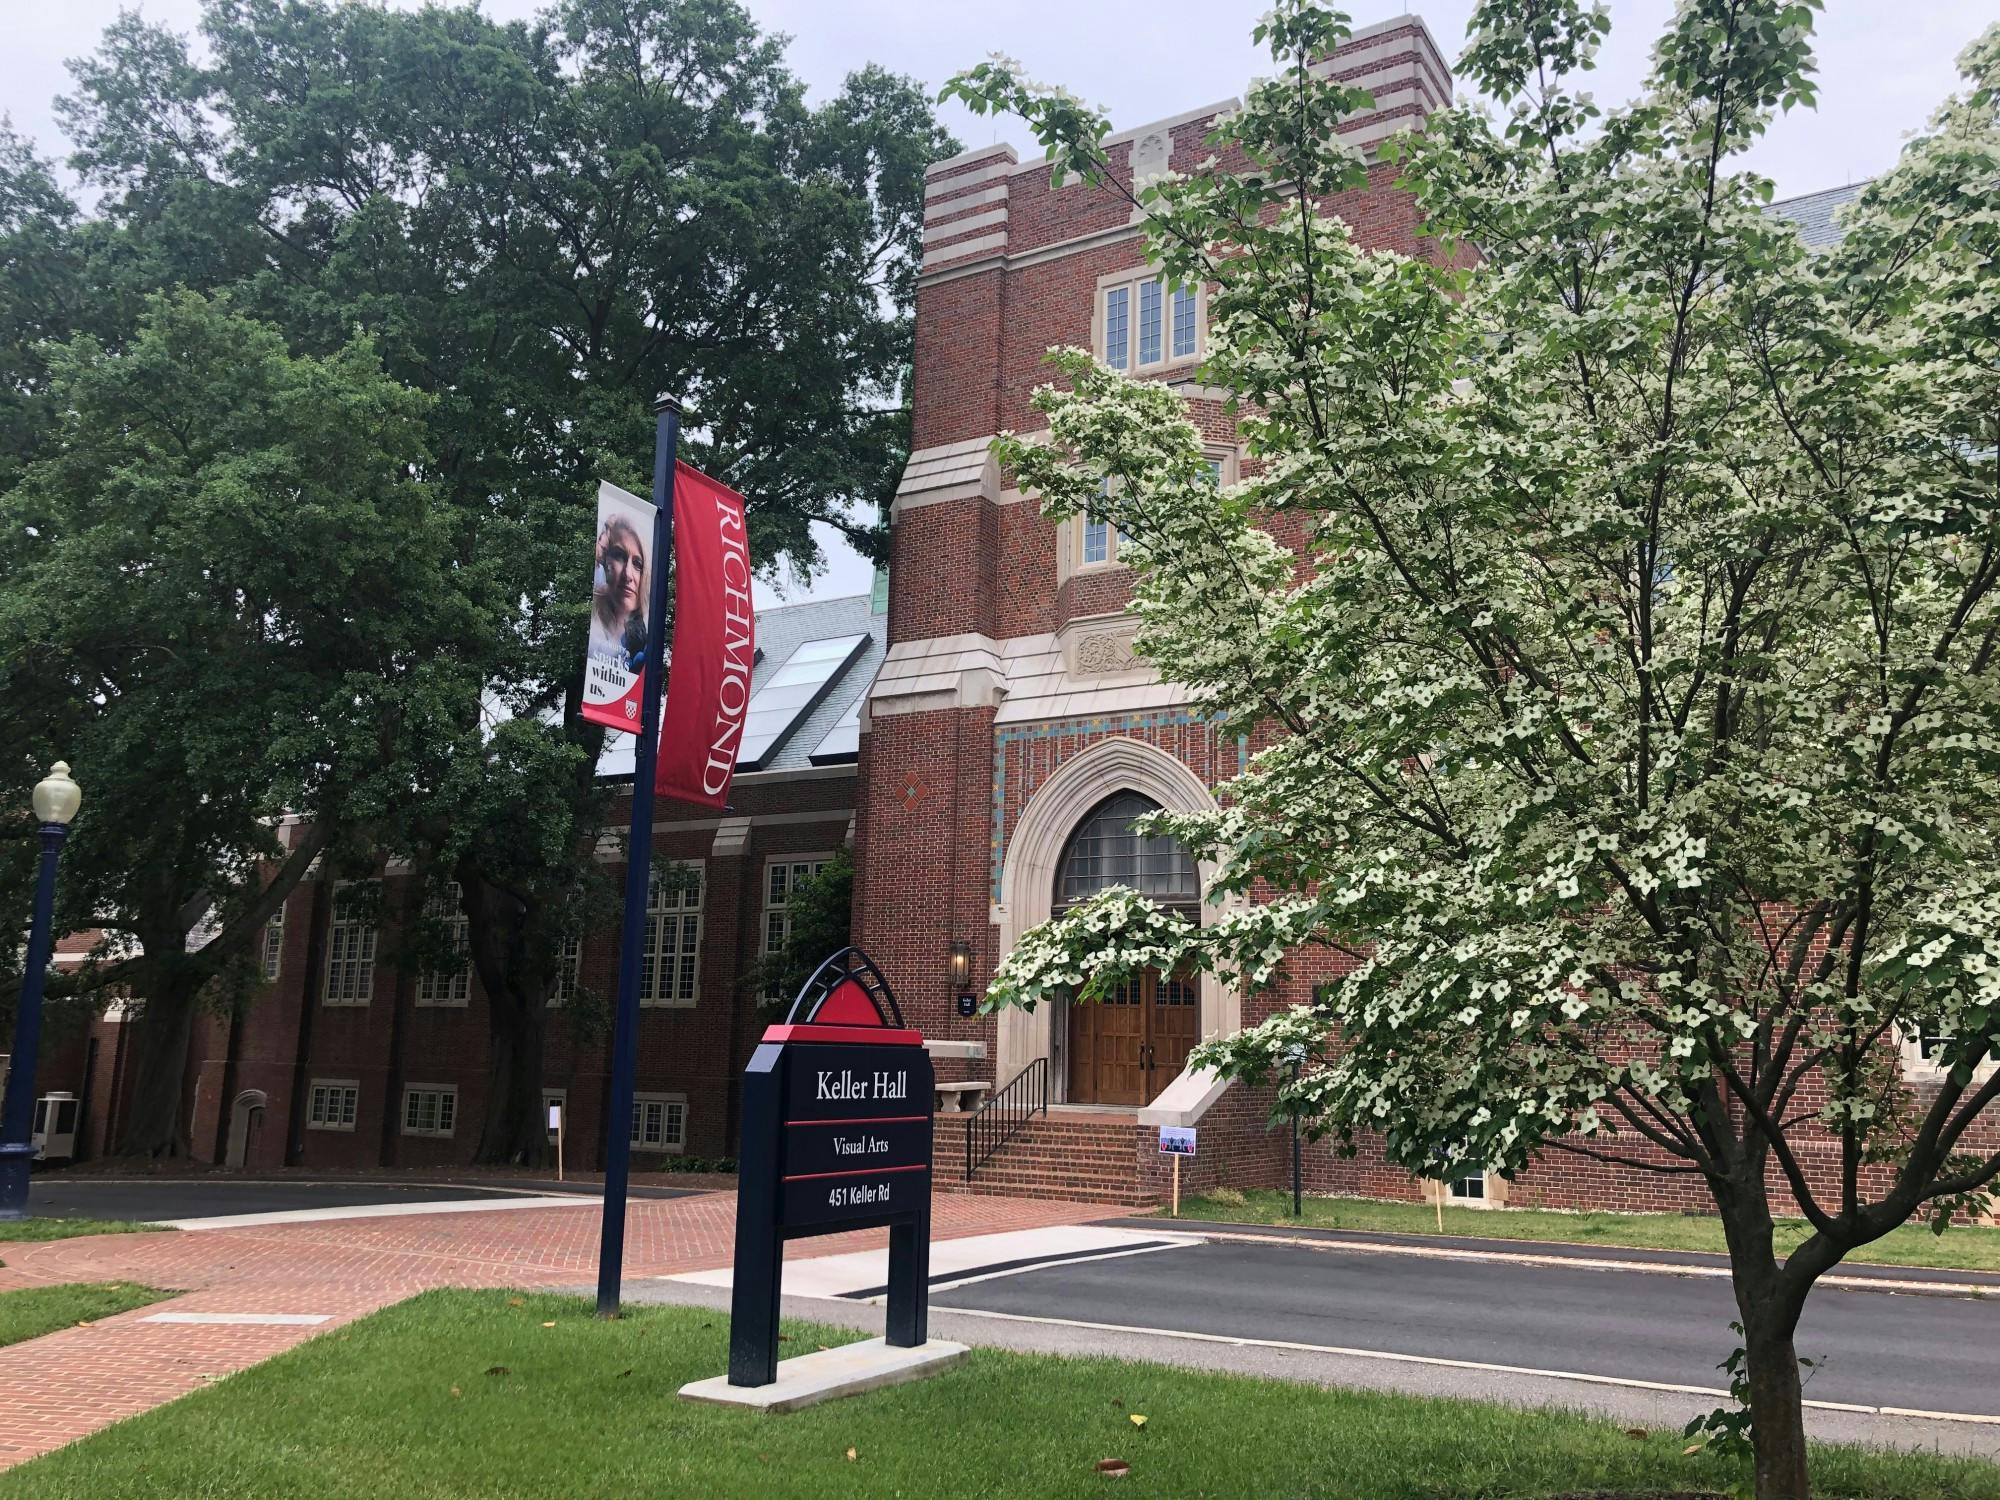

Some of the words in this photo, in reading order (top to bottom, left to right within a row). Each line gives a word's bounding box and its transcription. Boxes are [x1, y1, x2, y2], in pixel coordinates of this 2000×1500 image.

[703, 496, 750, 796] RICHMOND
[592, 665, 626, 688] within
[589, 683, 606, 698] us.
[816, 1069, 869, 1100] Keller
[872, 1070, 907, 1099] Hall
[833, 1135, 866, 1156] Visual
[867, 1135, 889, 1153] Arts
[828, 1187, 847, 1207] 451
[850, 1184, 877, 1205] Keller
[878, 1182, 890, 1202] Rd
